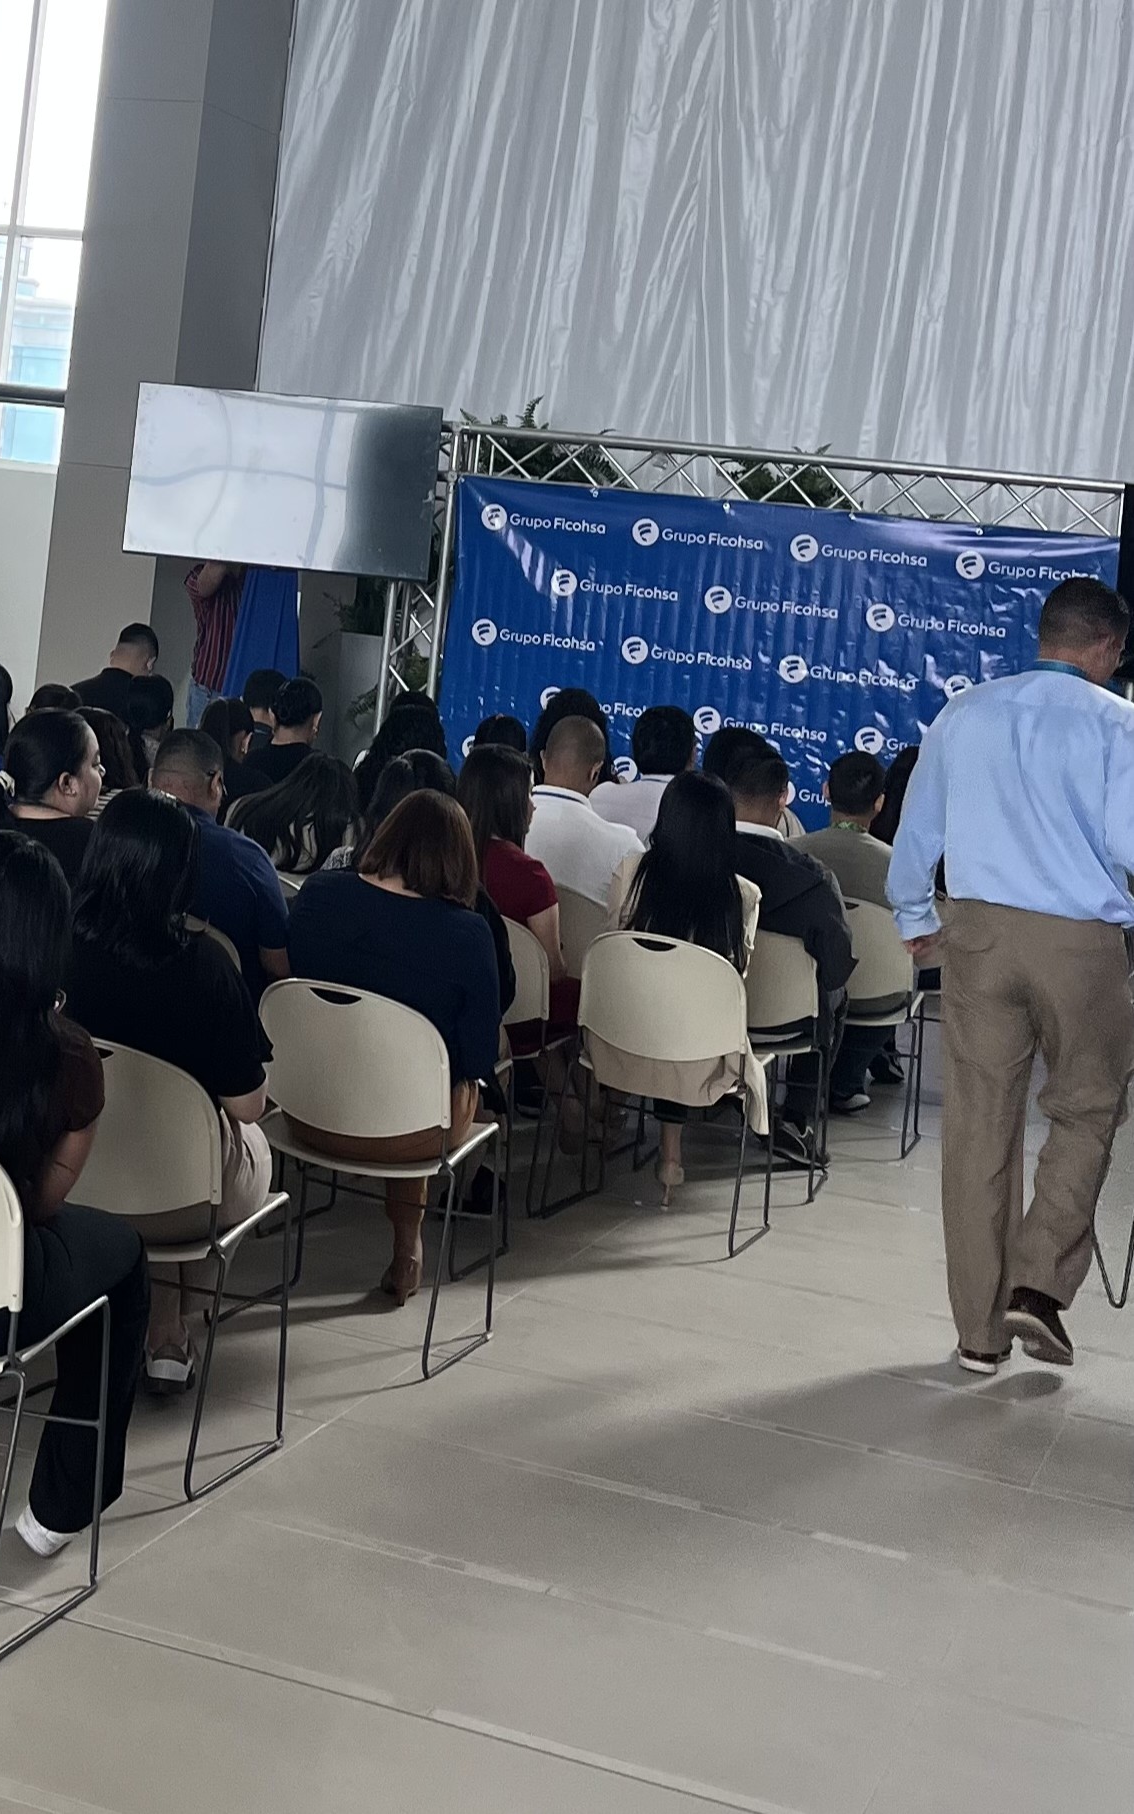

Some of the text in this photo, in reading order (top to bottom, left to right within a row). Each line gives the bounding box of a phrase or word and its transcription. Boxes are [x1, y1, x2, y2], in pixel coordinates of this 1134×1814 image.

[509, 513, 606, 534] Grupo Ficohsa
[661, 528, 764, 550] Grupo Ficohsa
[821, 544, 928, 567] Grupo Ficohsa
[988, 561, 1036, 579] Grupo
[579, 579, 679, 601] Grupo Ficohsa
[734, 596, 839, 619] Grupo Ficohsa
[897, 613, 1006, 638] Grupo Ficohsa
[499, 628, 596, 651] Grupo Ficohsa
[651, 647, 752, 671] Grupo Ficohsa
[810, 665, 917, 690] Grupo Ficohsa
[770, 722, 827, 741] Ficohsa
